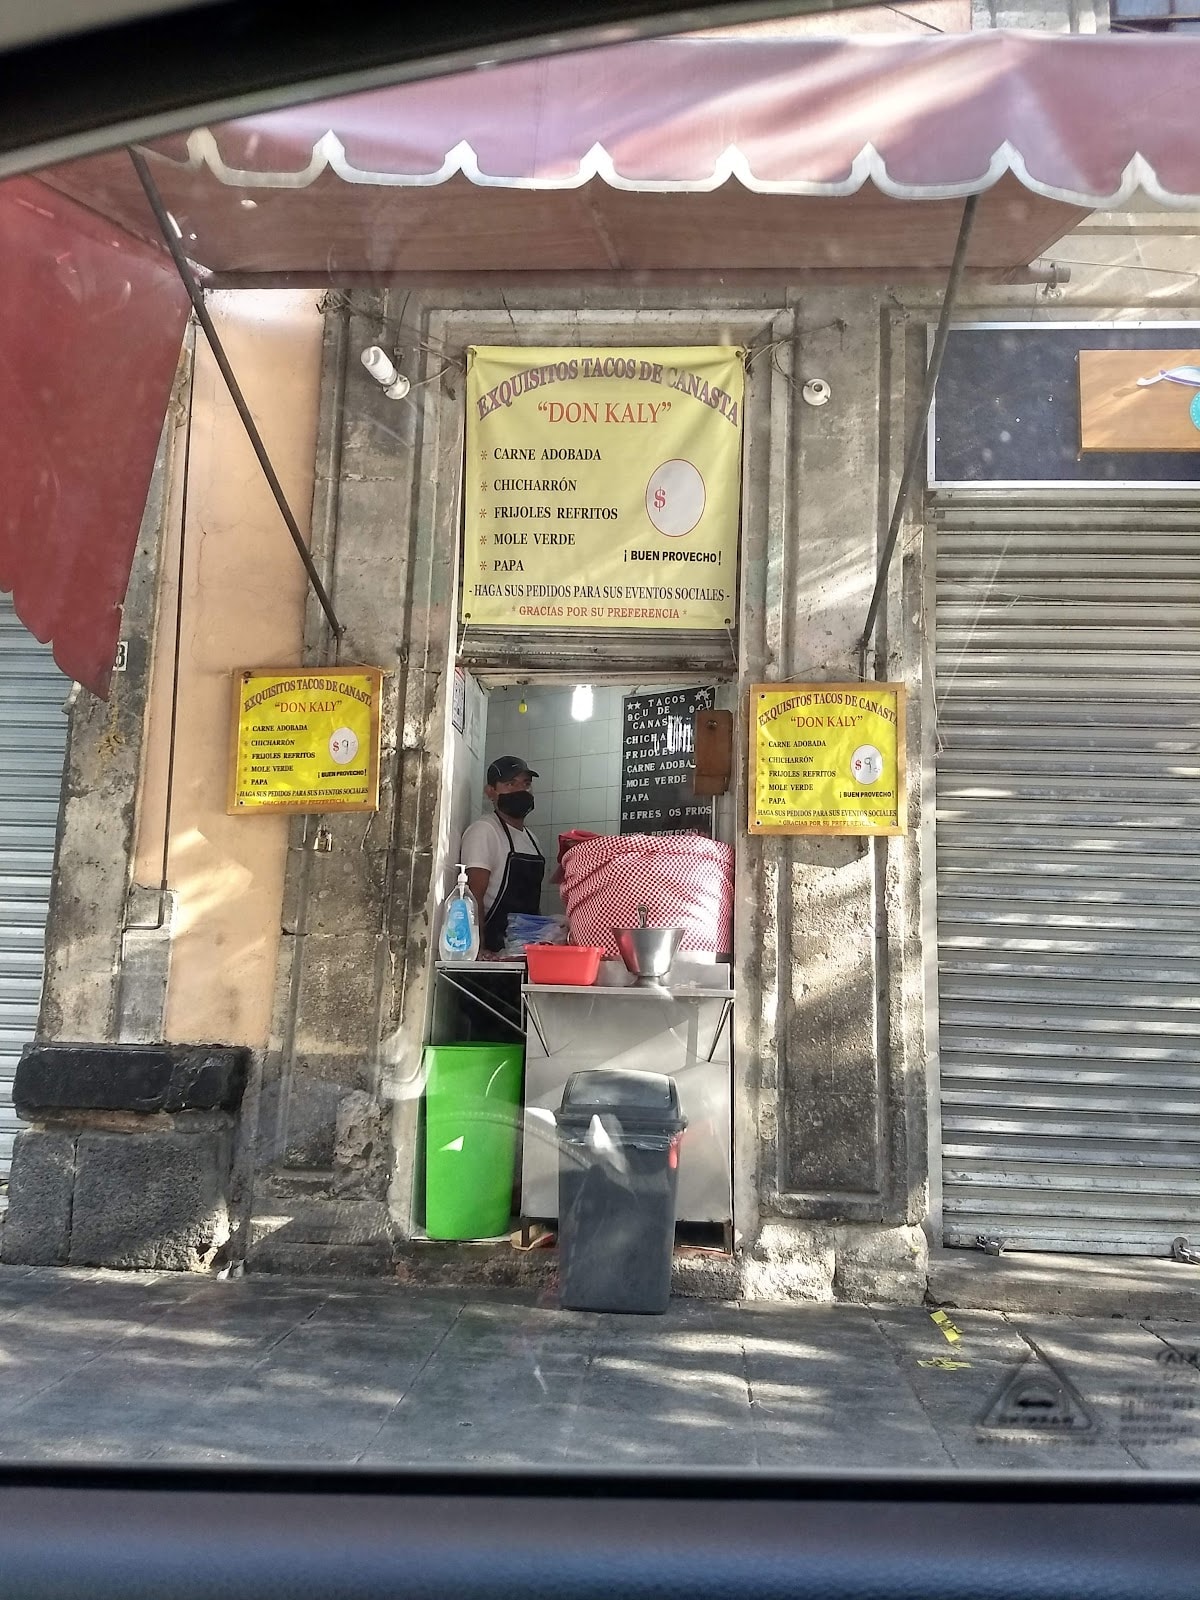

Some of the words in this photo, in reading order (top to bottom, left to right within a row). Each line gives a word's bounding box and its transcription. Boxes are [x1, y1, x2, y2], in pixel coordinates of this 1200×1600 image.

[477, 359, 578, 421] EXQUISITOS
[582, 357, 636, 379] TACOS
[638, 361, 663, 384] DE
[667, 367, 738, 427] CANASTA
[494, 448, 535, 460] CARNE
[541, 449, 601, 460] ADOBADA
[494, 477, 577, 491] CHICHARRÓN
[654, 487, 666, 512] $
[494, 507, 550, 519] FRIJOLES
[557, 507, 618, 520] REFRITOS
[494, 534, 528, 545] MOLE
[534, 534, 576, 545] VERDE
[494, 560, 524, 571] PAPA
[505, 585, 524, 596] SUS
[526, 586, 572, 597] PEDIDOS
[574, 586, 601, 598] PARA
[604, 586, 622, 599] SUS
[625, 587, 673, 599] EVENTOS
[519, 607, 563, 616] GRACIAS
[567, 607, 587, 617] POR
[591, 608, 604, 617] SU
[608, 608, 679, 618] PREFERENCIA
[244, 681, 295, 712] EXQUISITOS
[297, 679, 324, 690] TACOS
[326, 681, 338, 692] DE
[339, 683, 371, 708] CANAST
[648, 695, 686, 707] TACOS
[657, 706, 670, 714] DE
[758, 694, 812, 726] EXQUISITOS
[814, 693, 842, 704] TACOS
[845, 695, 857, 706] DE
[768, 755, 813, 763] CHICHARRÓN
[627, 763, 655, 773] CARNE
[660, 759, 696, 770] ADOBA
[626, 778, 649, 788] MOLE
[655, 775, 687, 785] VERDE
[625, 794, 649, 802] PAPA
[685, 806, 712, 816] FRIOS
[841, 809, 867, 817] EVENTOS
[868, 809, 896, 817] SOCIALES
